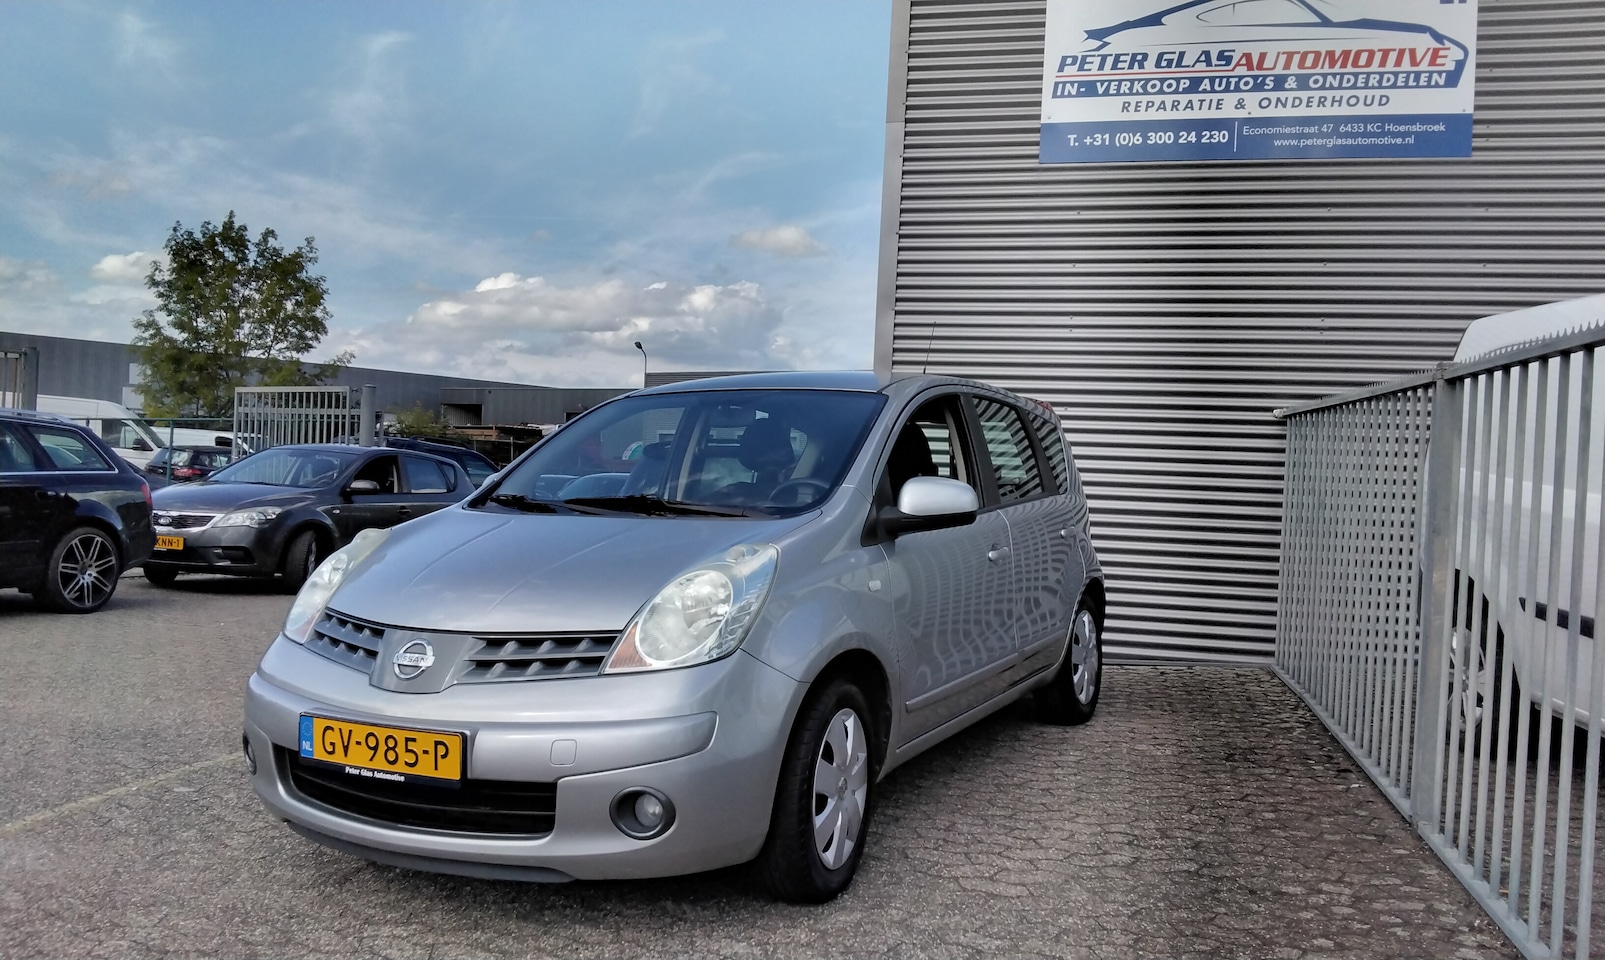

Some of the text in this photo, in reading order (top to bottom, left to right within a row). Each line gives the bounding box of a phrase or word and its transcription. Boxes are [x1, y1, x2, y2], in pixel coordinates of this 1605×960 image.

[1057, 52, 1149, 73] PETER
[1056, 72, 1447, 96] IN- VERKOOP AUTO'S & ONDERDELEN
[1121, 94, 1391, 113] REPARATIE & ONDERHOUD
[1243, 122, 1446, 135] Economiestraat 47 6433 KC Hoensbroek
[1067, 131, 1229, 148] T. +31 (0)6 300 24 230
[1273, 135, 1415, 148] www.peterglasautomotive.nl
[302, 740, 313, 751] NL
[321, 725, 449, 771] GV-985-P
[345, 766, 405, 782] Peter Glas Automotive
